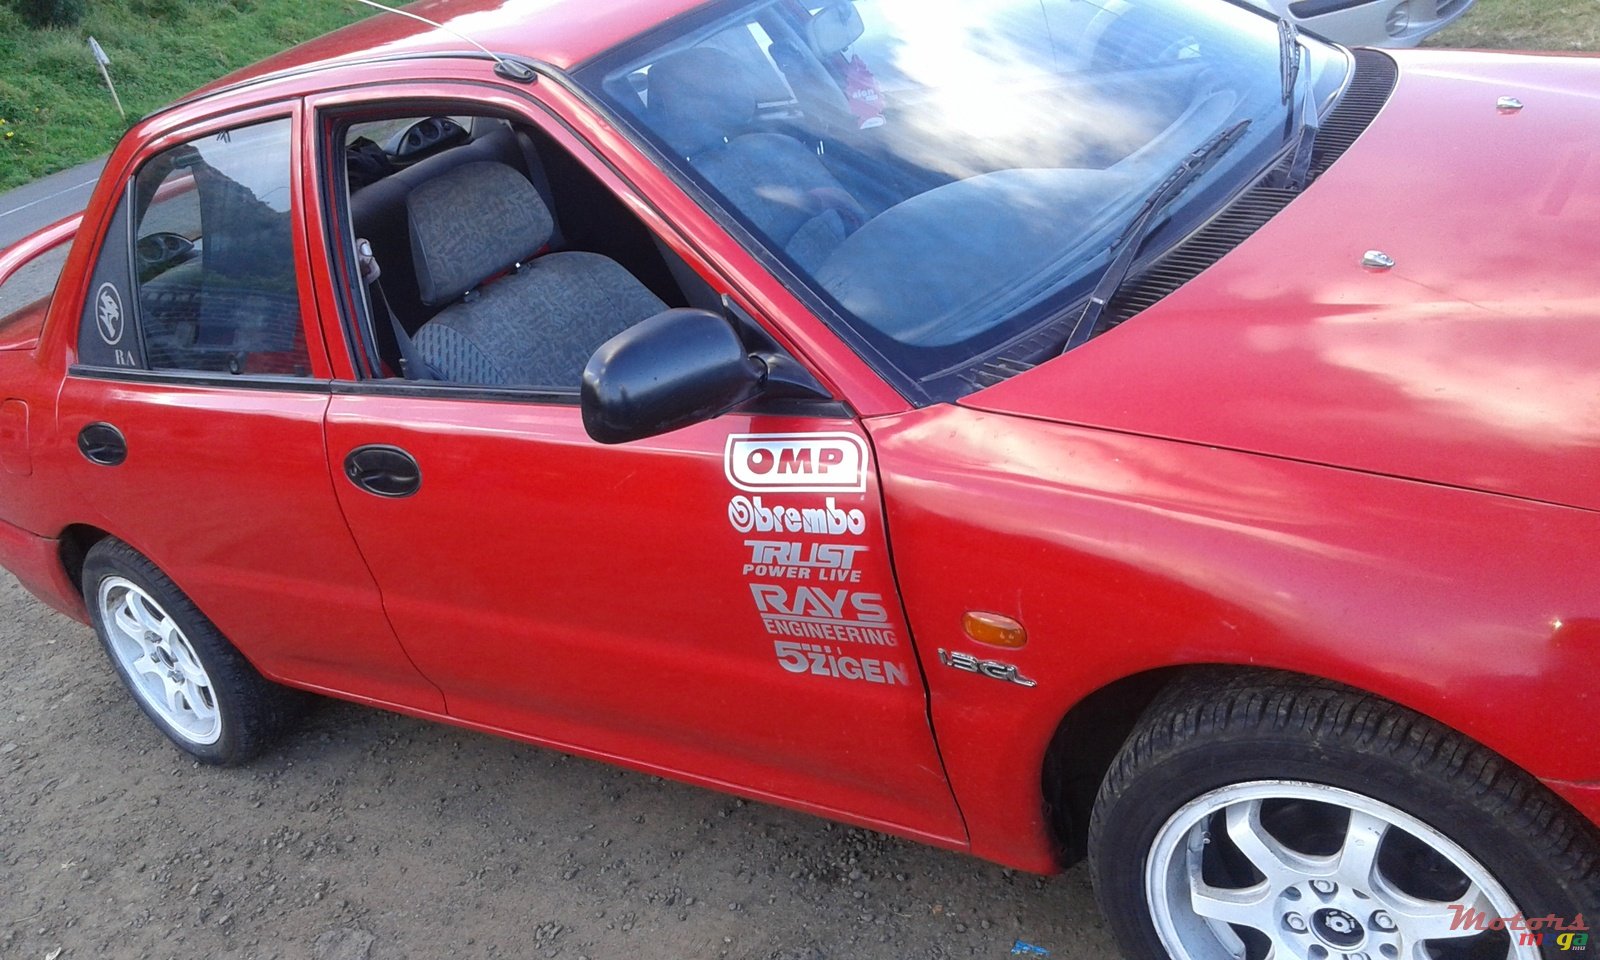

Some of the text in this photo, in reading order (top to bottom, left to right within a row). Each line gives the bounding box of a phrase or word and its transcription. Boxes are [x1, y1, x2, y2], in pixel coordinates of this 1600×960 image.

[746, 447, 844, 475] OMP
[752, 496, 866, 535] brembo
[744, 540, 870, 568] TRUST
[743, 564, 861, 582] POWER LIVE
[750, 583, 887, 622] RAYS
[765, 620, 897, 646] ENGINEERING
